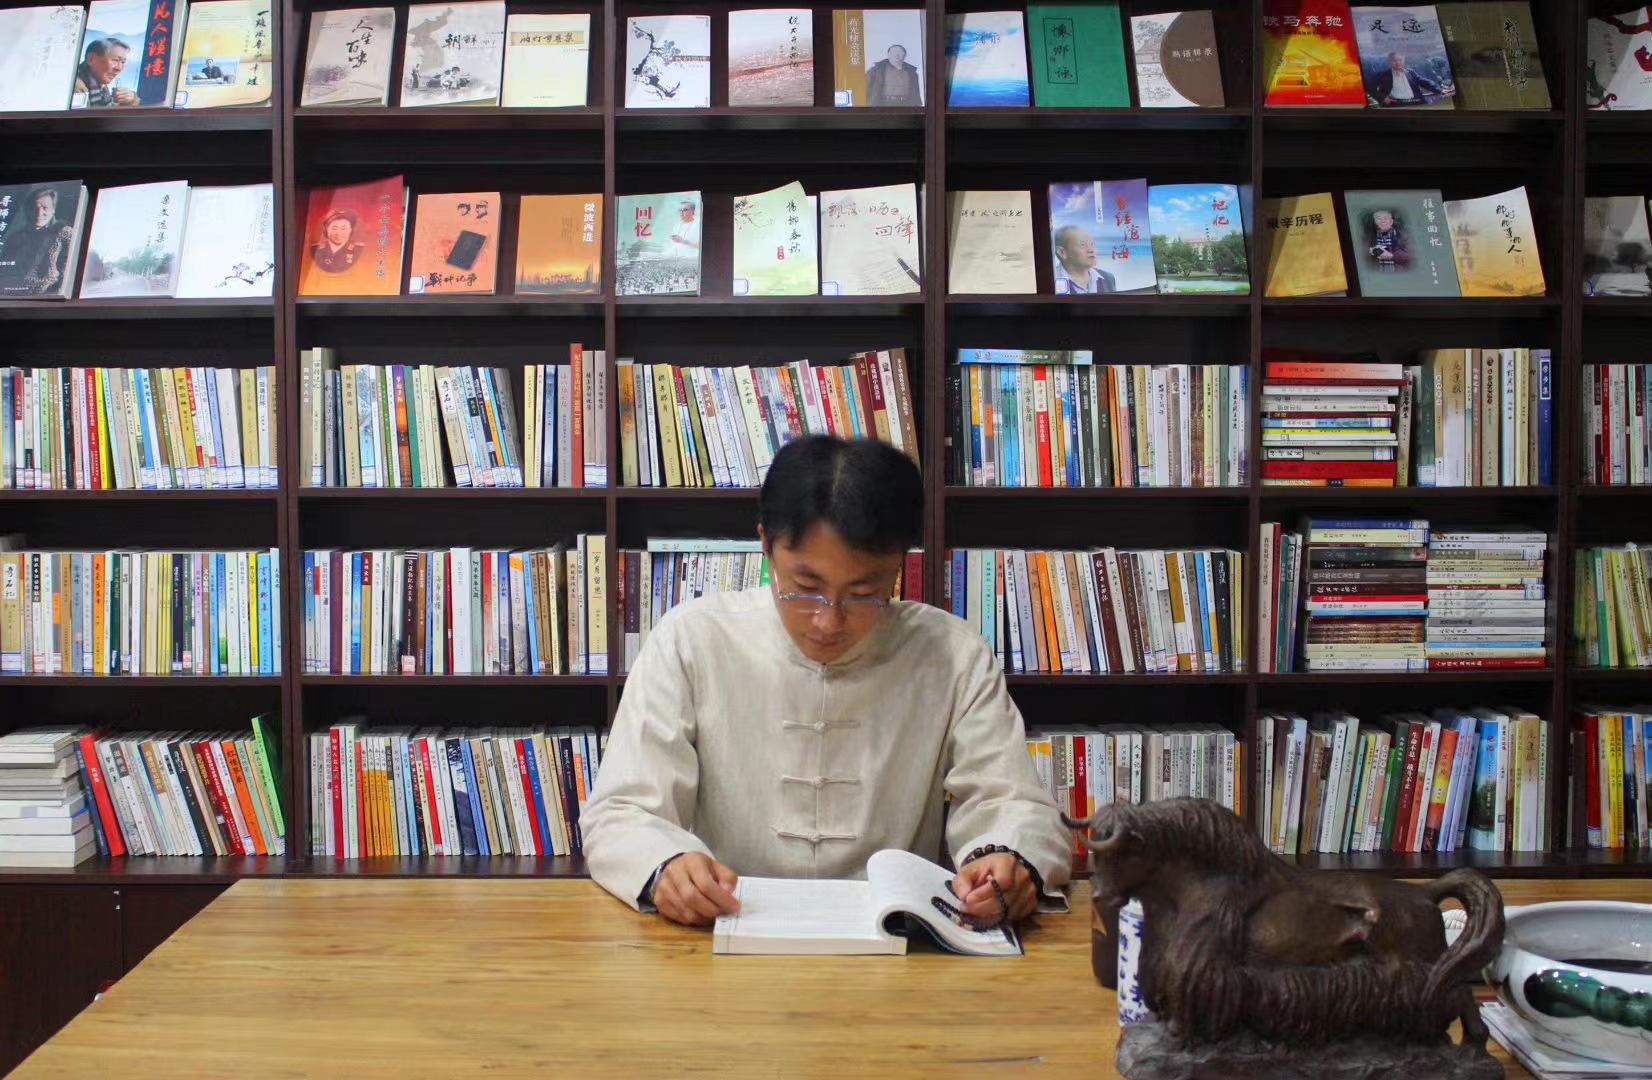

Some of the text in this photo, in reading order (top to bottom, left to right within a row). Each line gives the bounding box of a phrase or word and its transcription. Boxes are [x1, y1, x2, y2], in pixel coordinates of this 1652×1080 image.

[347, 20, 374, 69] 人生百味
[634, 206, 652, 237] 回忆
[1423, 199, 1443, 246] 往事回忆
